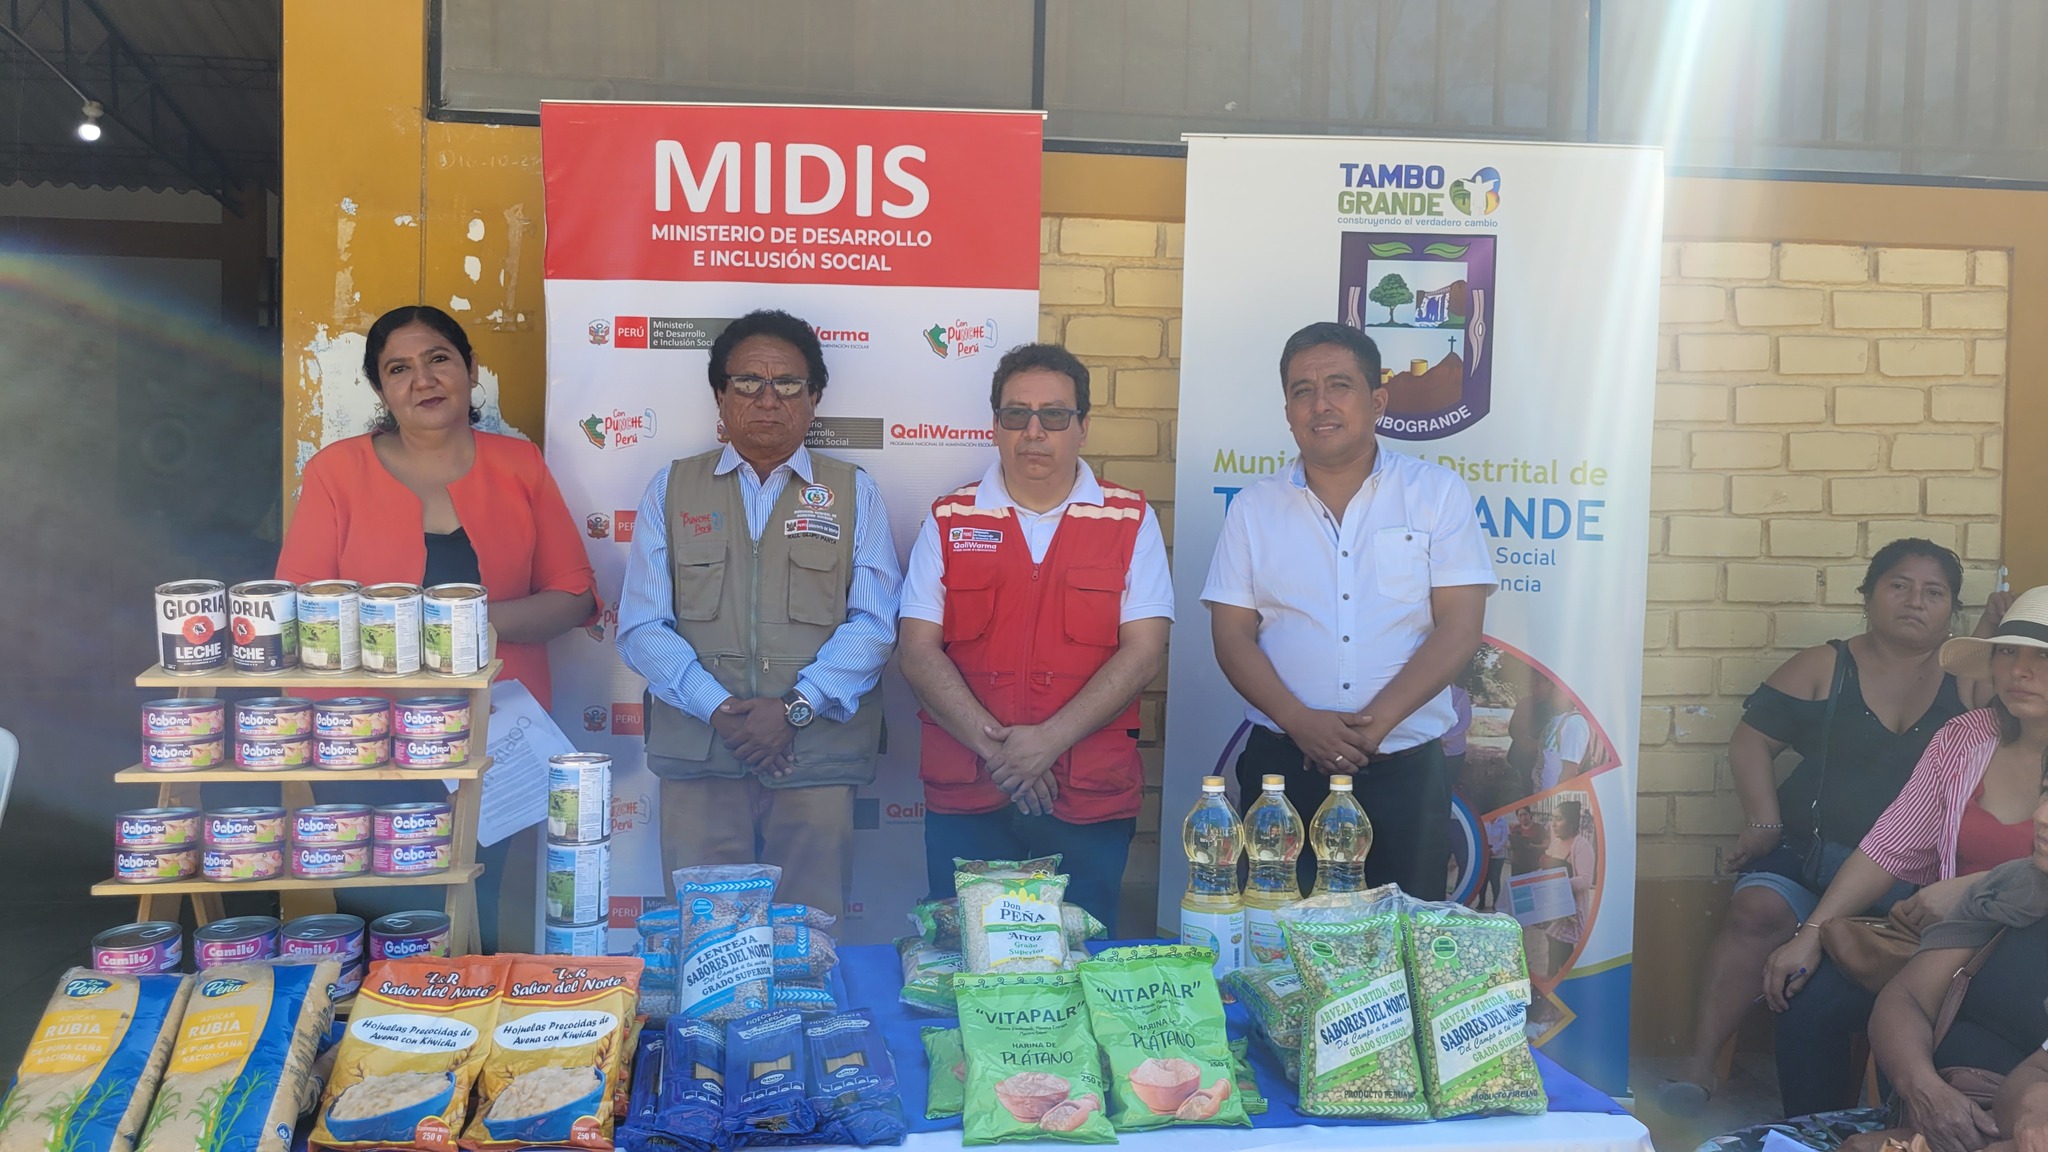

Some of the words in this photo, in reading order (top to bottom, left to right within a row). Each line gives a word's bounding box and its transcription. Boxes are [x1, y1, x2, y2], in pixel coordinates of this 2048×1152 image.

[655, 139, 930, 218] MIDIS
[1340, 163, 1445, 189] TAMBO
[1338, 191, 1444, 216] GRANDE
[1337, 217, 1402, 227] construyendo
[1405, 217, 1413, 225] el
[1416, 218, 1461, 227] verdadero
[1465, 219, 1498, 227] cambio
[651, 224, 765, 244] MINISTERIO
[770, 227, 797, 245] DE
[802, 227, 932, 248] DESARROLLO
[693, 250, 705, 266] E
[710, 248, 816, 270] INCLUSIÓN
[821, 254, 891, 272] SOCIAL
[653, 321, 694, 330] Ministerio
[956, 319, 968, 328] Con
[618, 326, 644, 338] PERÚ
[653, 330, 664, 338] de
[666, 330, 706, 338] Desarrollo
[660, 338, 695, 347] Inclusión
[697, 339, 715, 347] Soci
[957, 342, 979, 356] Perú
[613, 409, 625, 418] Con
[1375, 404, 1472, 433] BOGRANDE
[615, 432, 638, 447] Perú
[890, 423, 994, 440] QaliWarma
[826, 438, 849, 446] Social
[1570, 460, 1607, 486] de
[953, 542, 997, 550] QaliWarma
[1496, 547, 1556, 566] Social
[163, 594, 226, 621] GLORIA
[175, 642, 222, 660] LECHE
[233, 646, 265, 660] ECHE
[616, 713, 641, 724] PERÚ
[611, 818, 633, 833] Perú
[612, 905, 638, 917] PERÚ
[1003, 901, 1021, 911] Don
[1000, 908, 1046, 923] PEÑA
[1008, 932, 1043, 941] Arroz
[208, 943, 255, 957] Camilú
[696, 934, 758, 965] LENTEJA
[1009, 948, 1045, 956] Superior
[102, 952, 148, 966] Camilú
[686, 954, 730, 987] SABORES
[730, 948, 750, 967] DEL
[702, 977, 734, 996] GRADO
[735, 966, 772, 982] SUPERIOR
[703, 973, 718, 985] Del
[67, 979, 106, 996] Peña
[205, 980, 242, 996] Peña
[379, 981, 420, 997] Sabor
[422, 983, 447, 997] del
[511, 983, 551, 997] Sabor
[554, 979, 578, 994] del
[1320, 1001, 1352, 1025] ARVEJA
[1352, 987, 1388, 1011] PARTIDA
[1439, 1008, 1471, 1032] ARVEJA
[1471, 995, 1506, 1015] PARTIDA
[503, 1023, 546, 1035] Hojuelas
[549, 1017, 598, 1030] Precocidas
[599, 1015, 610, 1025] de
[746, 1012, 771, 1026] FIDEOS
[1137, 1018, 1168, 1031] HARINA
[1320, 1010, 1368, 1045] SABORES
[1368, 1003, 1386, 1026] DEL
[1386, 993, 1410, 1016] NORTE
[45, 1023, 101, 1038] RUBIA
[188, 1020, 241, 1038] RUBIA
[362, 1019, 407, 1033] Hojuelas
[409, 1025, 458, 1038] Precocidas
[460, 1028, 472, 1037] de
[1440, 1014, 1488, 1052] SABORES
[1489, 1007, 1508, 1030] DEL
[369, 1032, 399, 1042] Avena
[420, 1036, 456, 1048] Kiwicha
[512, 1035, 541, 1046] Avena
[543, 1034, 560, 1042] con
[561, 1028, 598, 1040] Kiwicha
[1130, 1029, 1196, 1052] PLÁTANO
[1335, 1036, 1350, 1051] Del
[1351, 1027, 1375, 1046] Campo
[1349, 1040, 1376, 1057] GRADO
[1376, 1027, 1407, 1048] SUPERIOR
[1457, 1042, 1472, 1056] Del
[1473, 1032, 1497, 1050] Campo
[190, 1042, 215, 1053] PURA
[217, 1039, 244, 1049] CAÑA
[1472, 1046, 1500, 1063] GRADO
[1499, 1030, 1526, 1051] SUPERI
[1001, 1049, 1074, 1066] PLÁTANO
[1081, 1074, 1096, 1084] 250
[1344, 1089, 1383, 1099] PRODUCTO
[422, 1132, 436, 1141] 250
